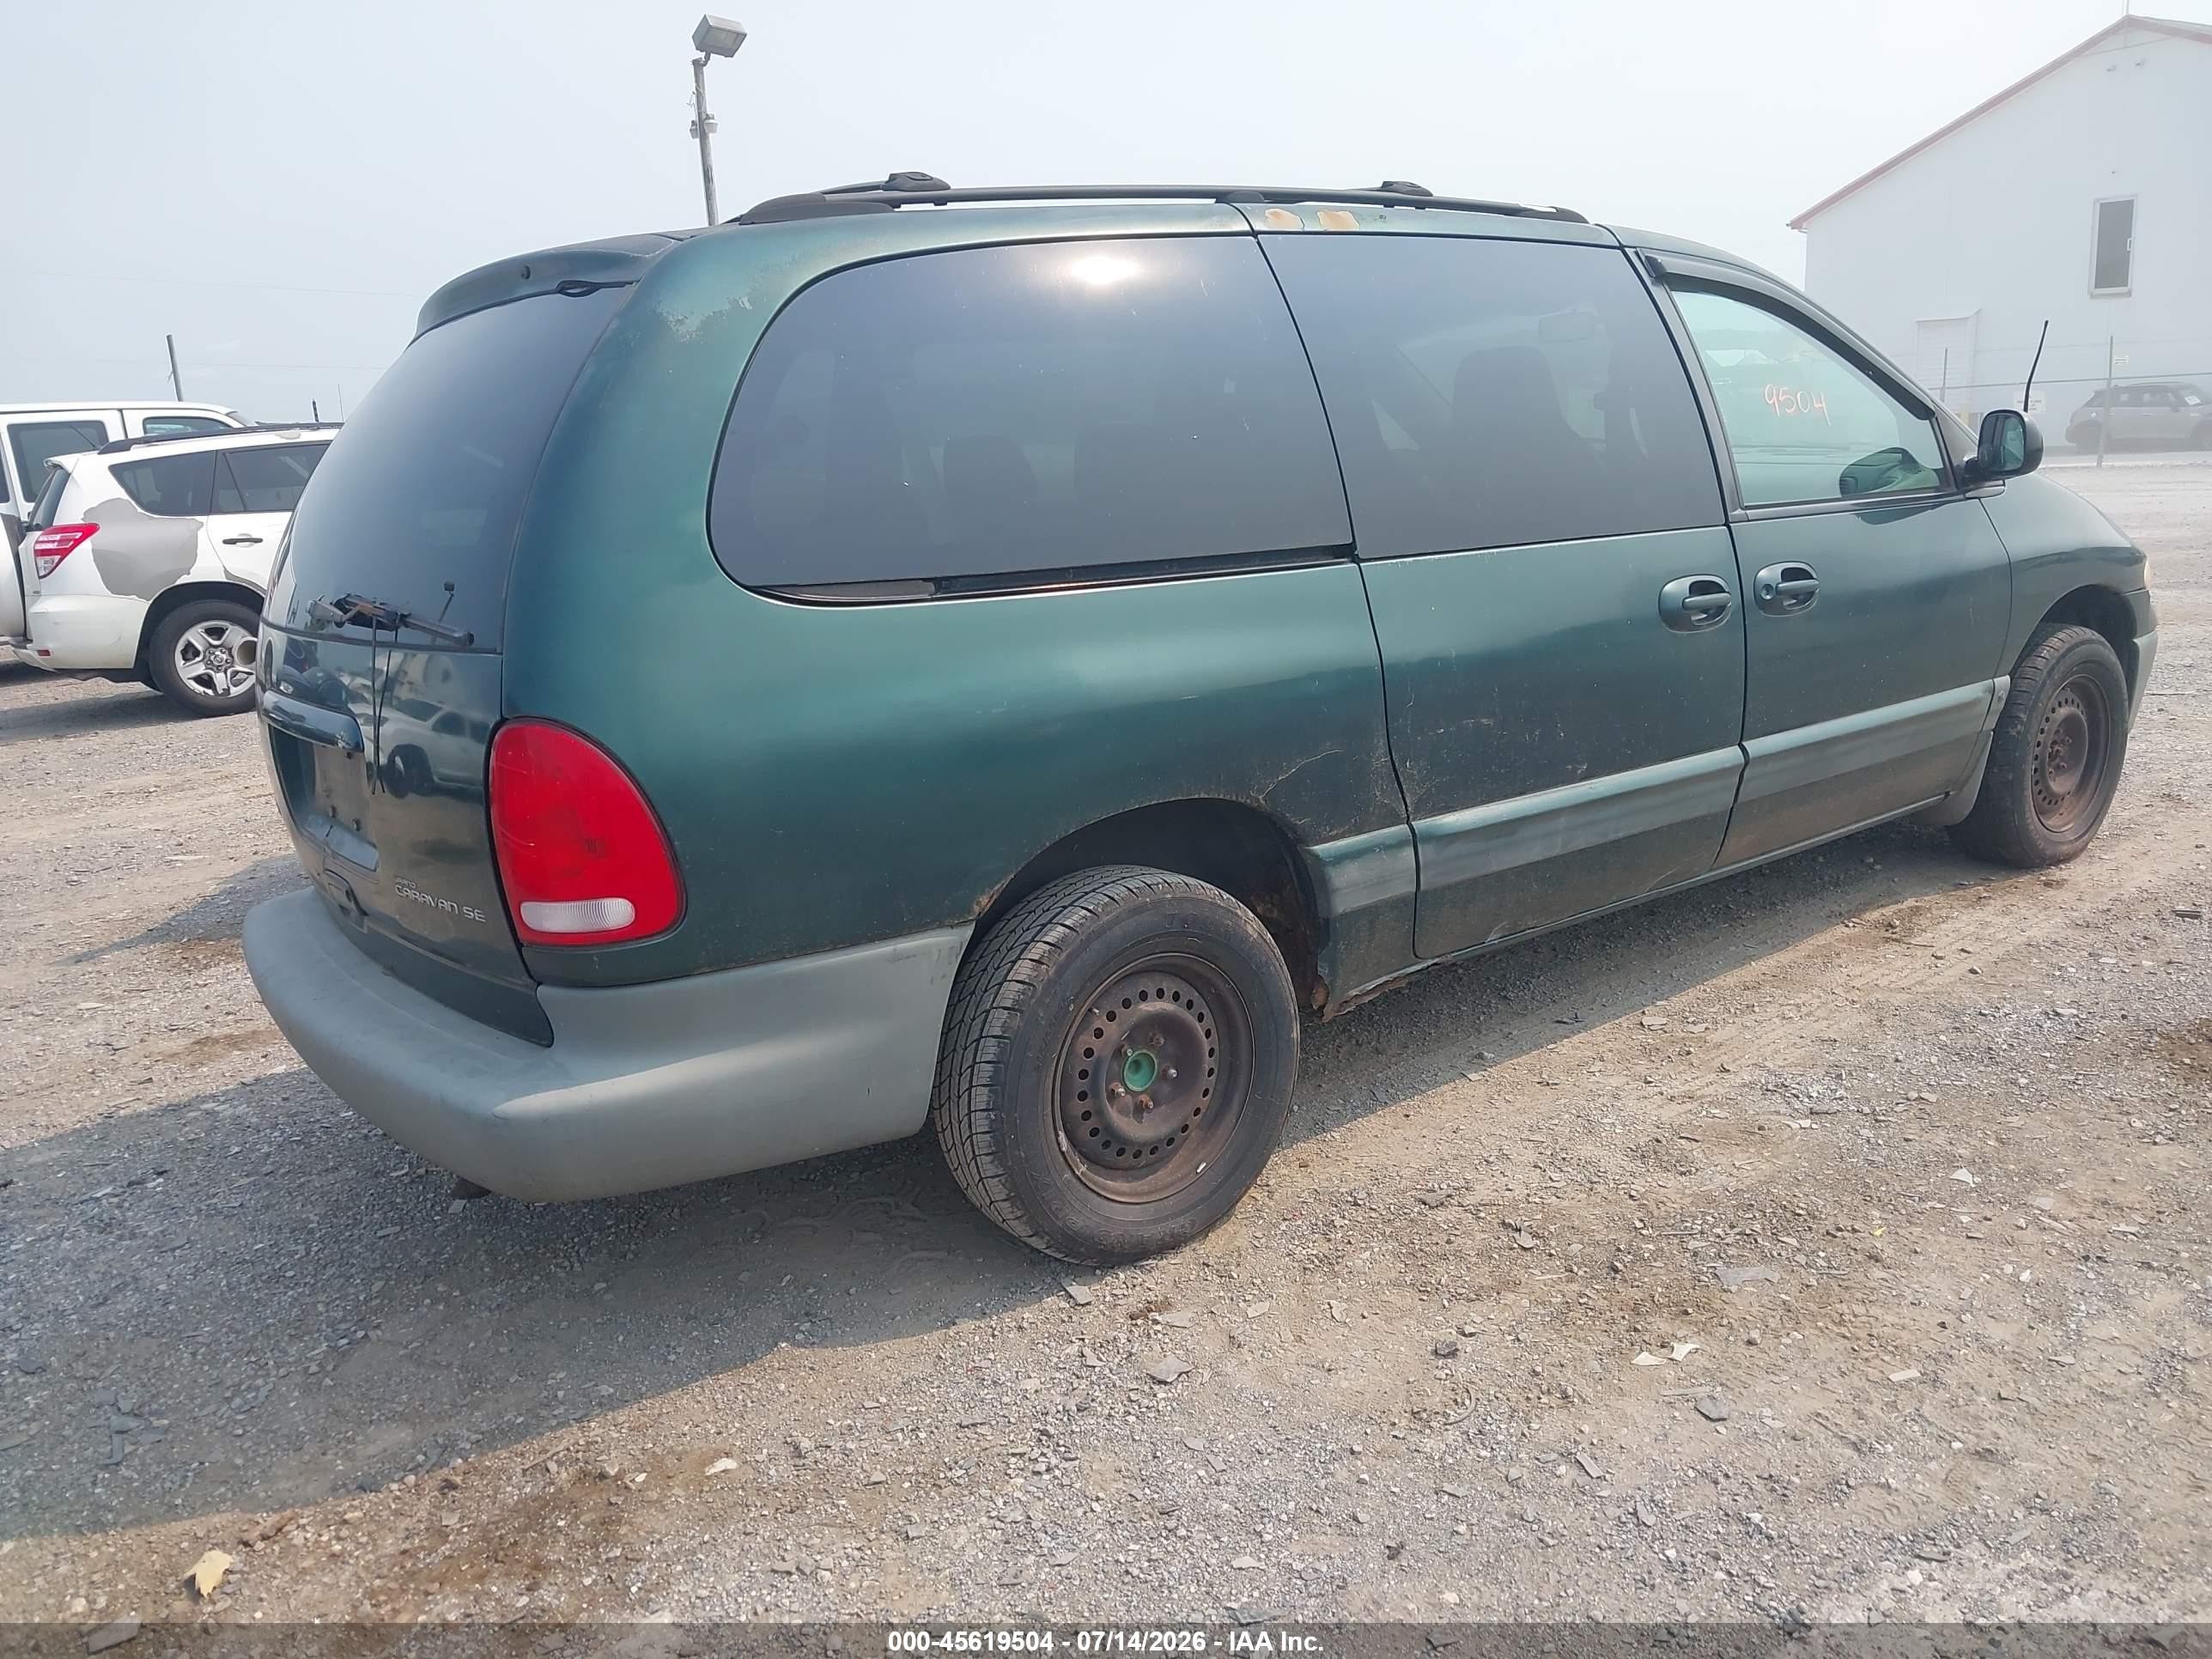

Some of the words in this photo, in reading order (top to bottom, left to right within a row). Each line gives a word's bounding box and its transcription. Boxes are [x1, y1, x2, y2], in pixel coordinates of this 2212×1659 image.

[1765, 384, 1832, 426] 9504
[394, 884, 459, 915] CARAVAN
[462, 906, 488, 923] SE
